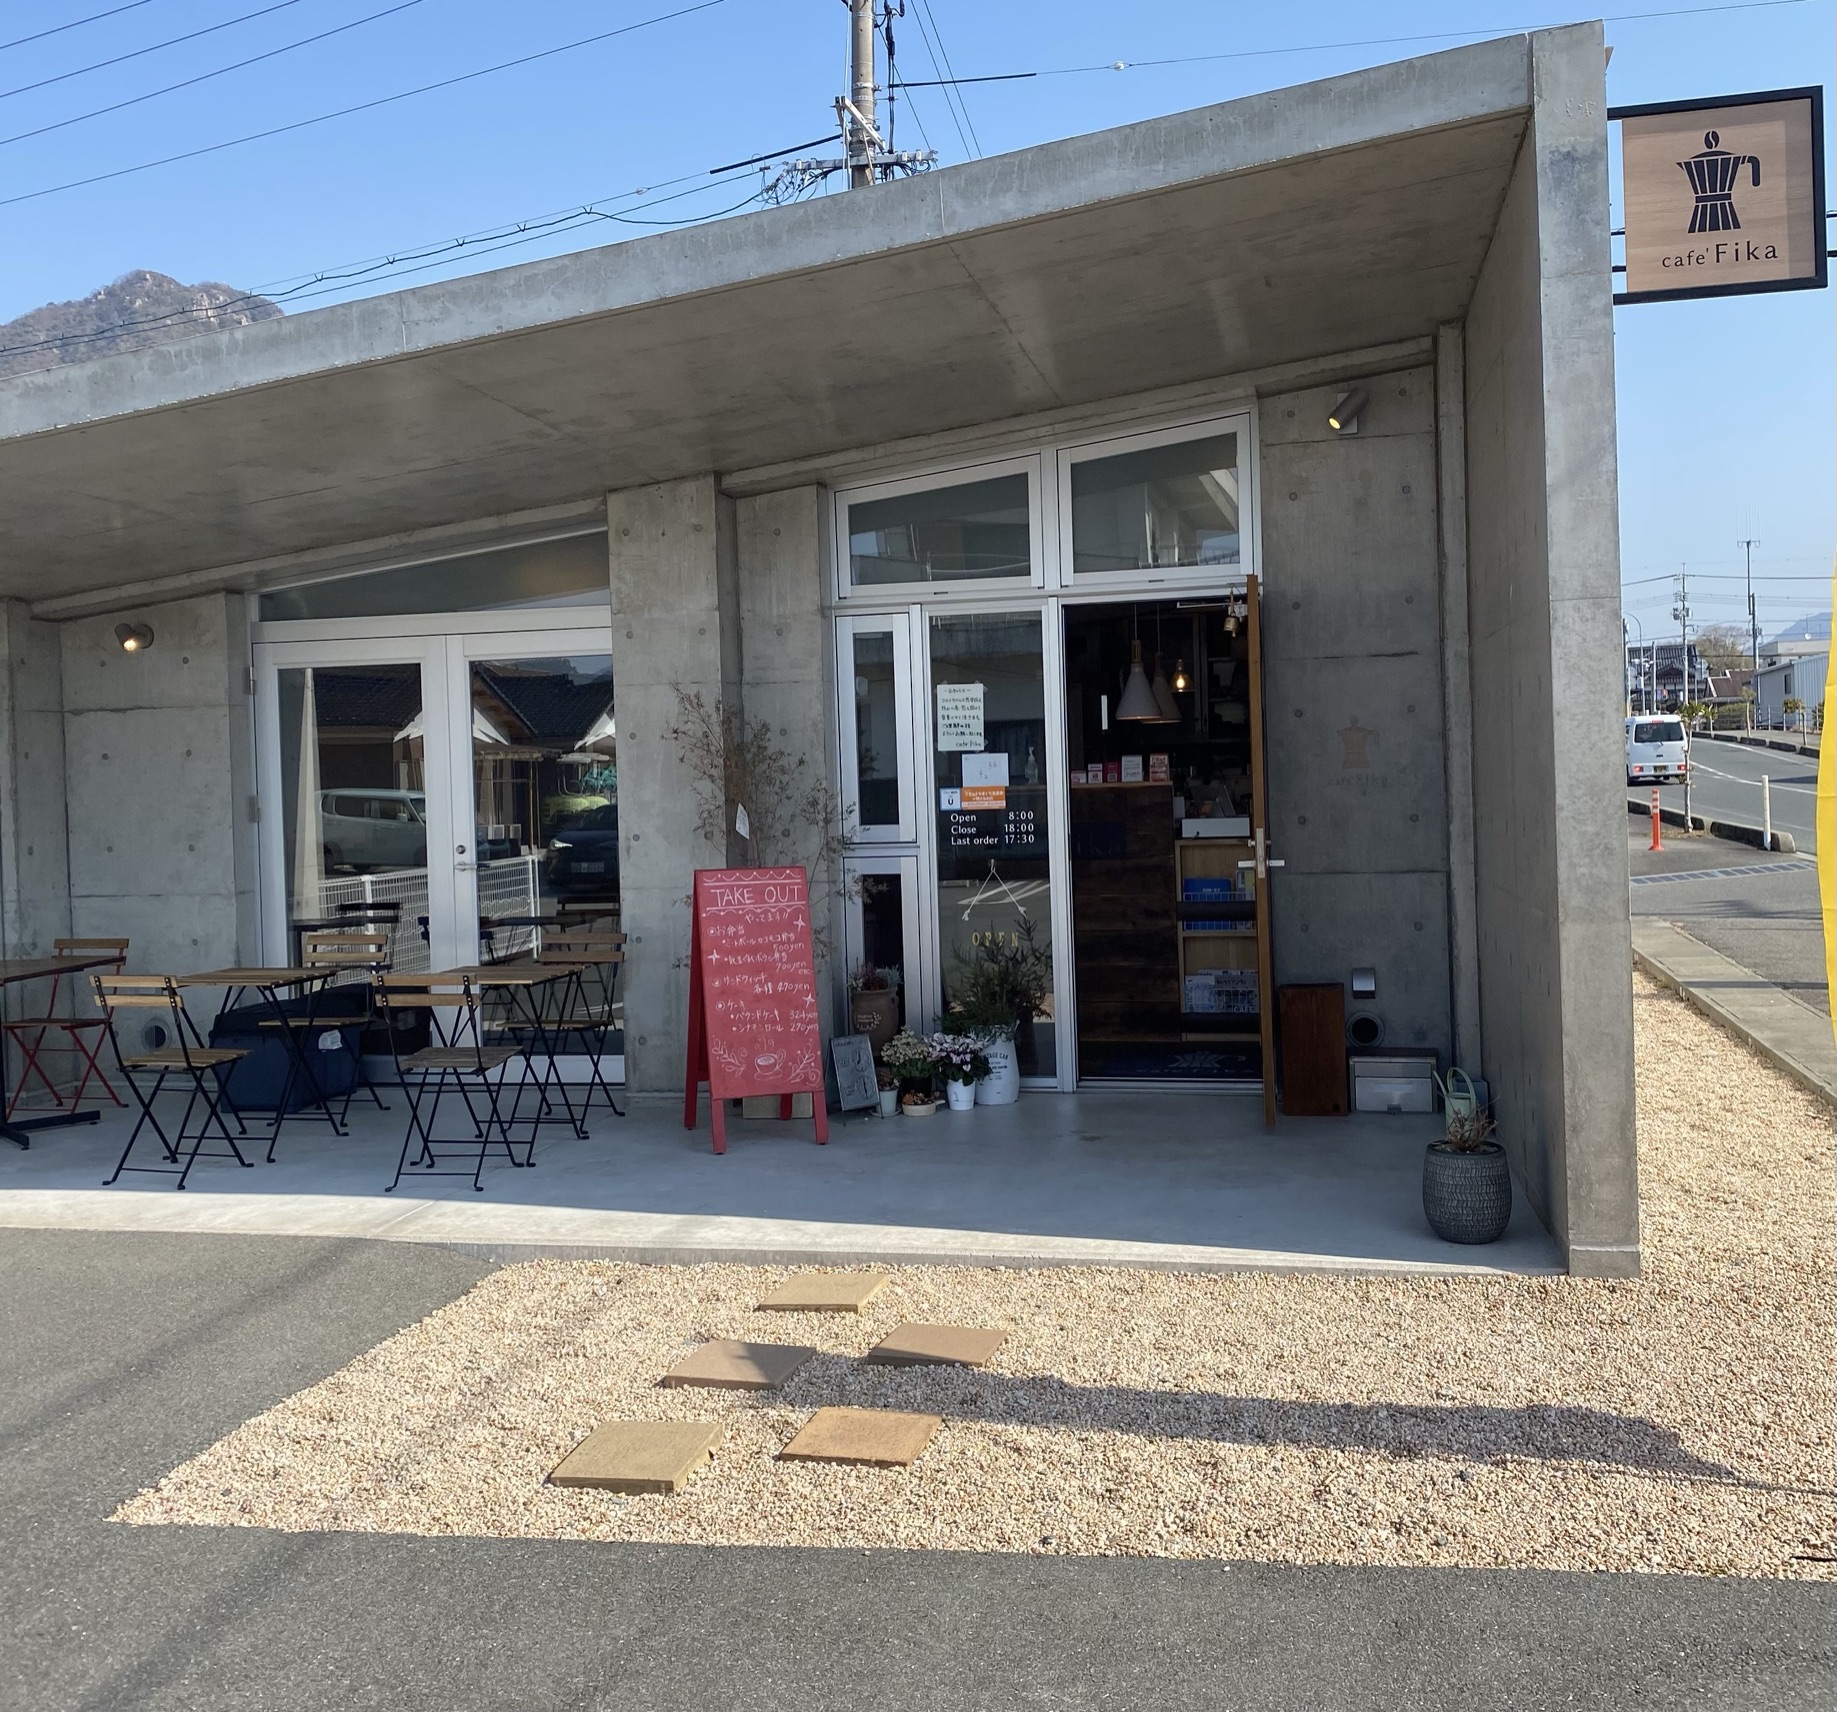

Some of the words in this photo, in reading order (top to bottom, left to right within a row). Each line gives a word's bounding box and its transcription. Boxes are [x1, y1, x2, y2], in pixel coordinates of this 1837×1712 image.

[1715, 240, 1778, 264] Fika
[950, 813, 977, 825] Open
[1008, 811, 1034, 820] 8:00
[951, 825, 977, 835] Close
[1004, 823, 1034, 833] 18:00
[951, 836, 970, 846] Last
[974, 835, 998, 845] order
[1004, 834, 1035, 844] 17:30
[710, 886, 755, 907] TAKE
[764, 885, 802, 903] OUT
